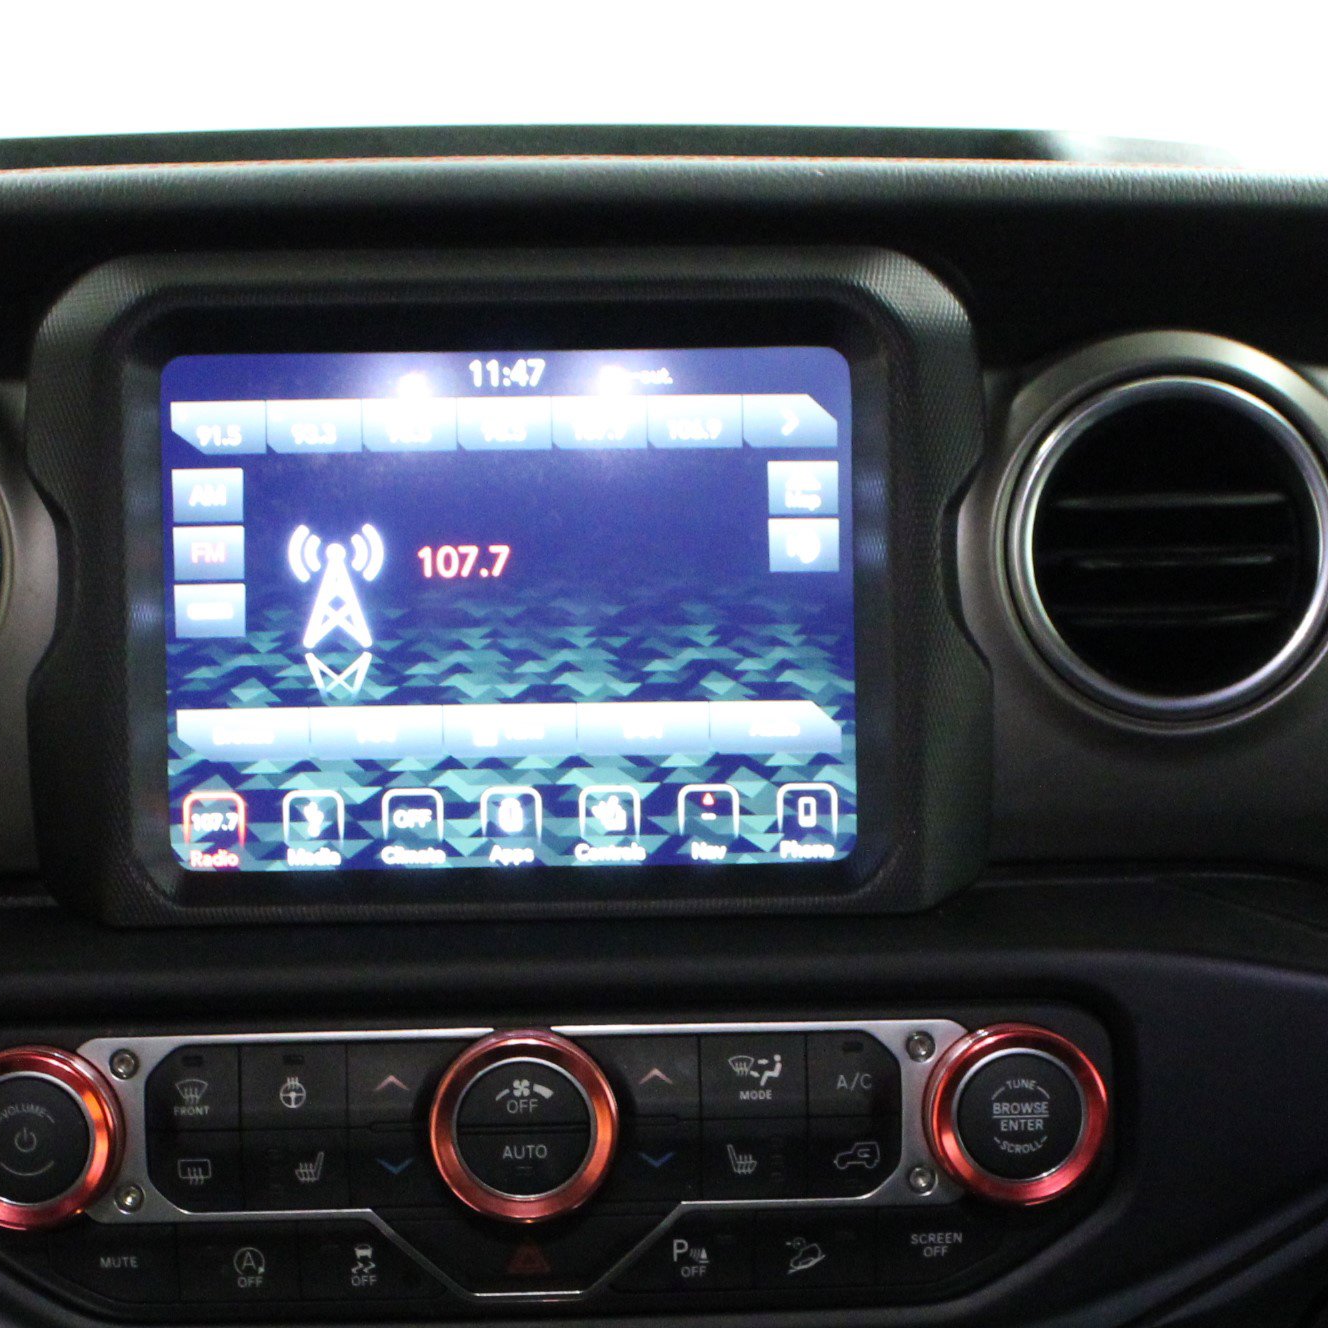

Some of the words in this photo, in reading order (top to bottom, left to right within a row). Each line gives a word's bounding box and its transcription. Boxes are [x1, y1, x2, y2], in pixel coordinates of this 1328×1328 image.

[469, 359, 546, 387] 11:47
[195, 424, 242, 447] 91.5
[188, 484, 227, 507] AM
[190, 542, 227, 564] FM
[417, 545, 511, 579] 107.7
[392, 808, 432, 828] OFF
[286, 847, 341, 866] Media
[381, 845, 446, 865] Climate
[489, 844, 534, 866] Apps
[574, 843, 646, 862] Controls
[691, 841, 727, 860] Nav
[779, 840, 835, 859] Phone
[190, 849, 239, 868] Radio
[836, 1073, 873, 1091] A/C
[1005, 1079, 1037, 1091] TUNE
[739, 1089, 773, 1101] MODE
[0, 1102, 49, 1119] VOLUME
[173, 1105, 210, 1117] FRONT
[506, 1100, 538, 1114] OFF
[992, 1101, 1049, 1115] BROWSE
[1000, 1118, 1044, 1132] ENTER
[502, 1145, 548, 1160] AUTO
[999, 1140, 1042, 1154] SCROLL
[910, 1232, 963, 1246] SCREEN
[923, 1246, 949, 1258] OFF
[100, 1256, 139, 1269] MUTE
[681, 1266, 707, 1278] OFF
[237, 1276, 263, 1288] OFF
[351, 1275, 377, 1287] OFF
